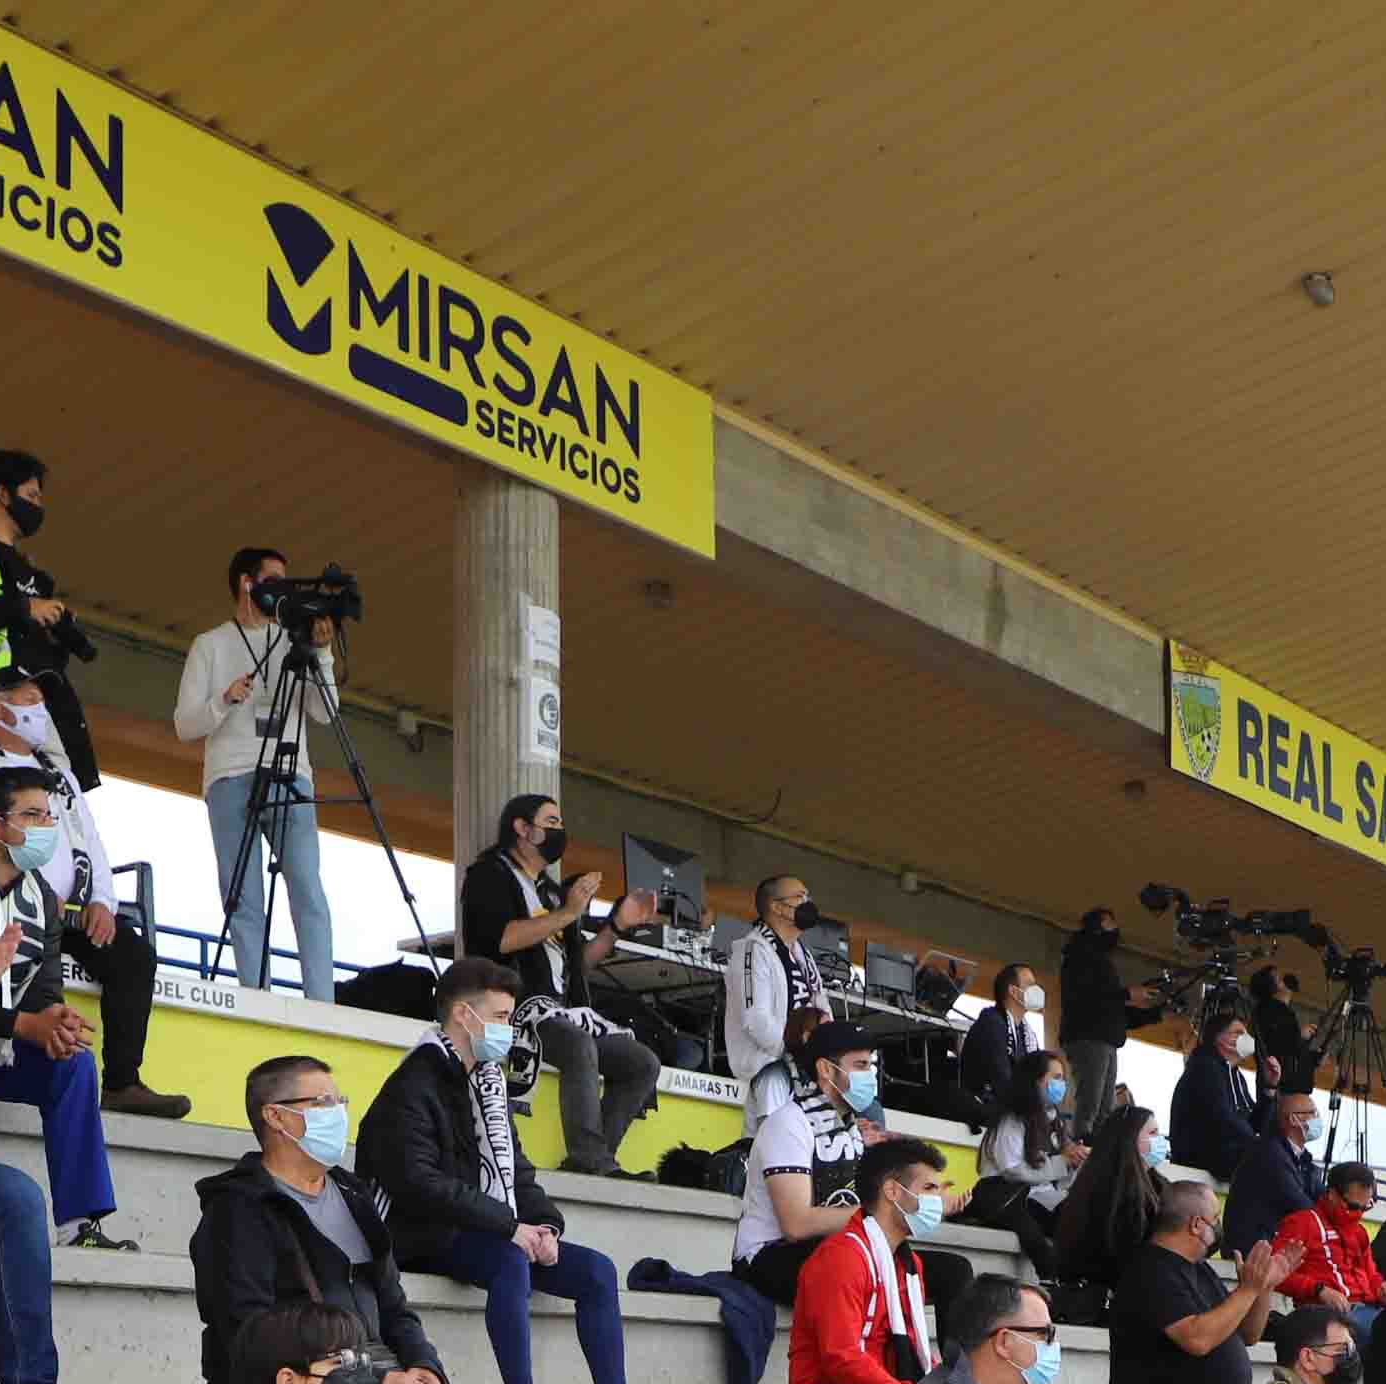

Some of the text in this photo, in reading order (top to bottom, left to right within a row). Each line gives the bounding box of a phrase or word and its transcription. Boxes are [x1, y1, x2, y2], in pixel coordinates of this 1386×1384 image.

[347, 238, 641, 461] MIRSAN
[475, 399, 642, 505] SERVICIOS
[1237, 696, 1344, 824] REAL
[190, 986, 236, 1010] CLUB
[725, 1084, 739, 1098] TV
